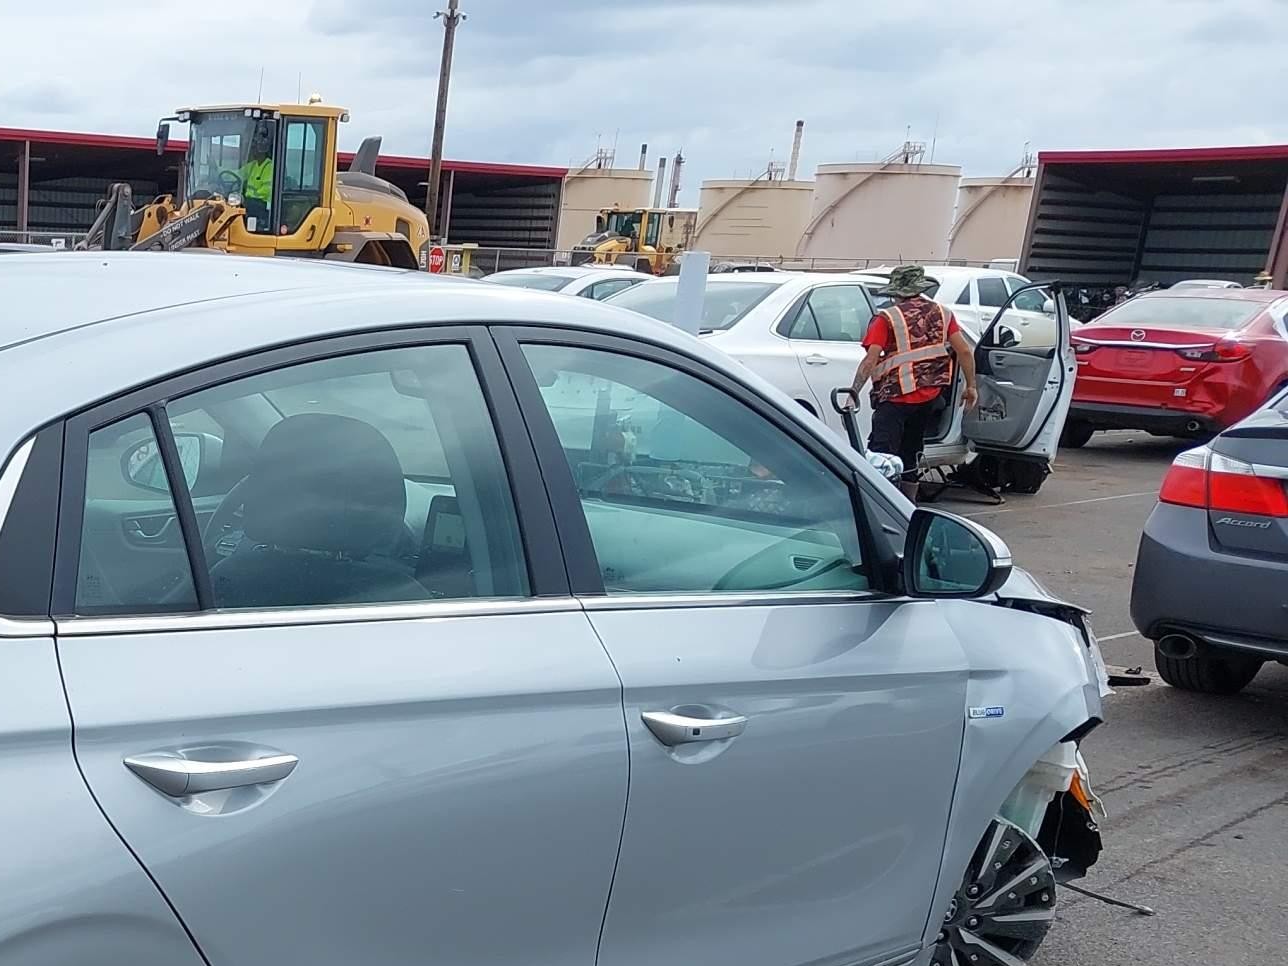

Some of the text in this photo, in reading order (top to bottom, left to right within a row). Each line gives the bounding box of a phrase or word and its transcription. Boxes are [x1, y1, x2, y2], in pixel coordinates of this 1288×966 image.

[172, 222, 183, 232] NOT
[184, 213, 200, 224] WALK
[430, 255, 443, 265] STOP
[1215, 517, 1272, 529] Accord
